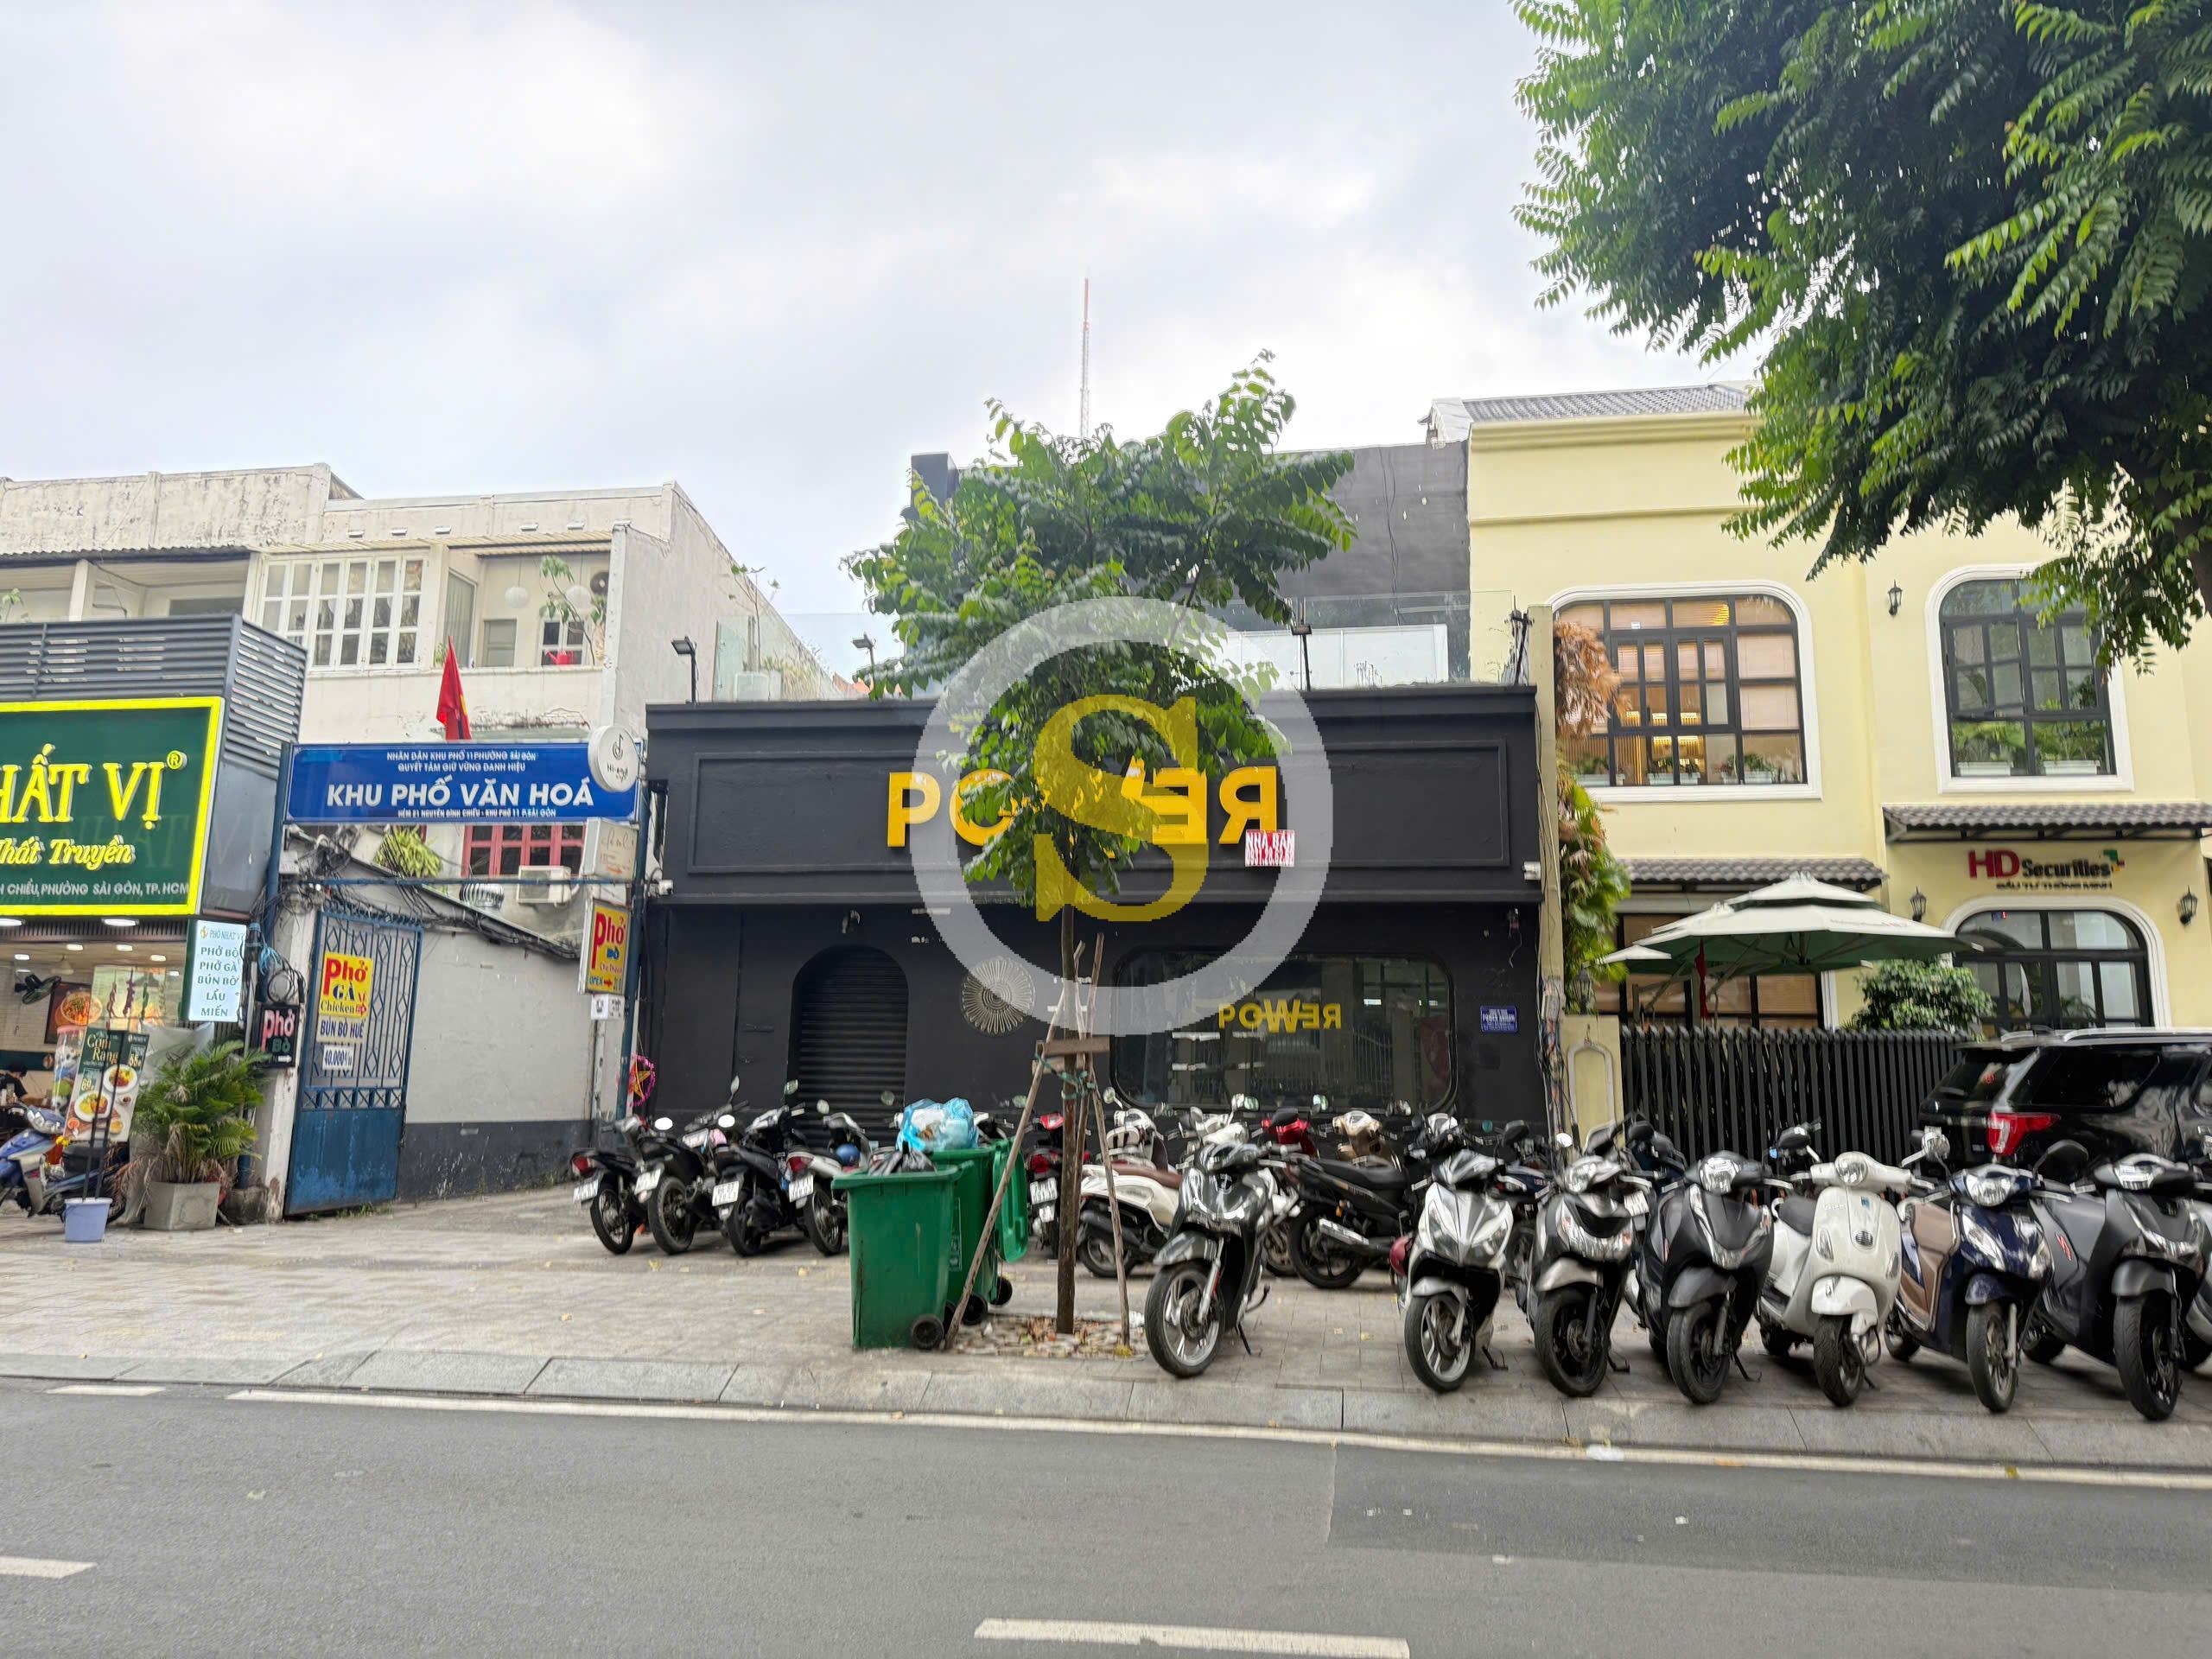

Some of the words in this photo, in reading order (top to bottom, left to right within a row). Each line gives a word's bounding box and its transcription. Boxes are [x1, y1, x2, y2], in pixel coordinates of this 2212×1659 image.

[430, 751, 447, 760] KHU
[327, 783, 383, 807] KHU
[391, 774, 454, 806] PHỐ
[460, 779, 520, 806] VĂN
[529, 777, 594, 806] HOÁ
[887, 760, 1277, 851] POER
[1968, 849, 2019, 880] HD
[92, 880, 111, 895] SÀI
[200, 945, 223, 957] PHỞ
[591, 912, 626, 969] Phở
[200, 960, 222, 971] PHỞ
[224, 962, 238, 972] GÀ
[323, 957, 369, 996] Phở
[197, 974, 220, 986] BÚN
[332, 982, 355, 1001] GÀ
[321, 1001, 355, 1014] Chicken
[1218, 998, 1342, 1033] POWER
[262, 1009, 295, 1052] Phở
[321, 1017, 337, 1037] BÚN
[350, 1019, 365, 1039] HUẾ
